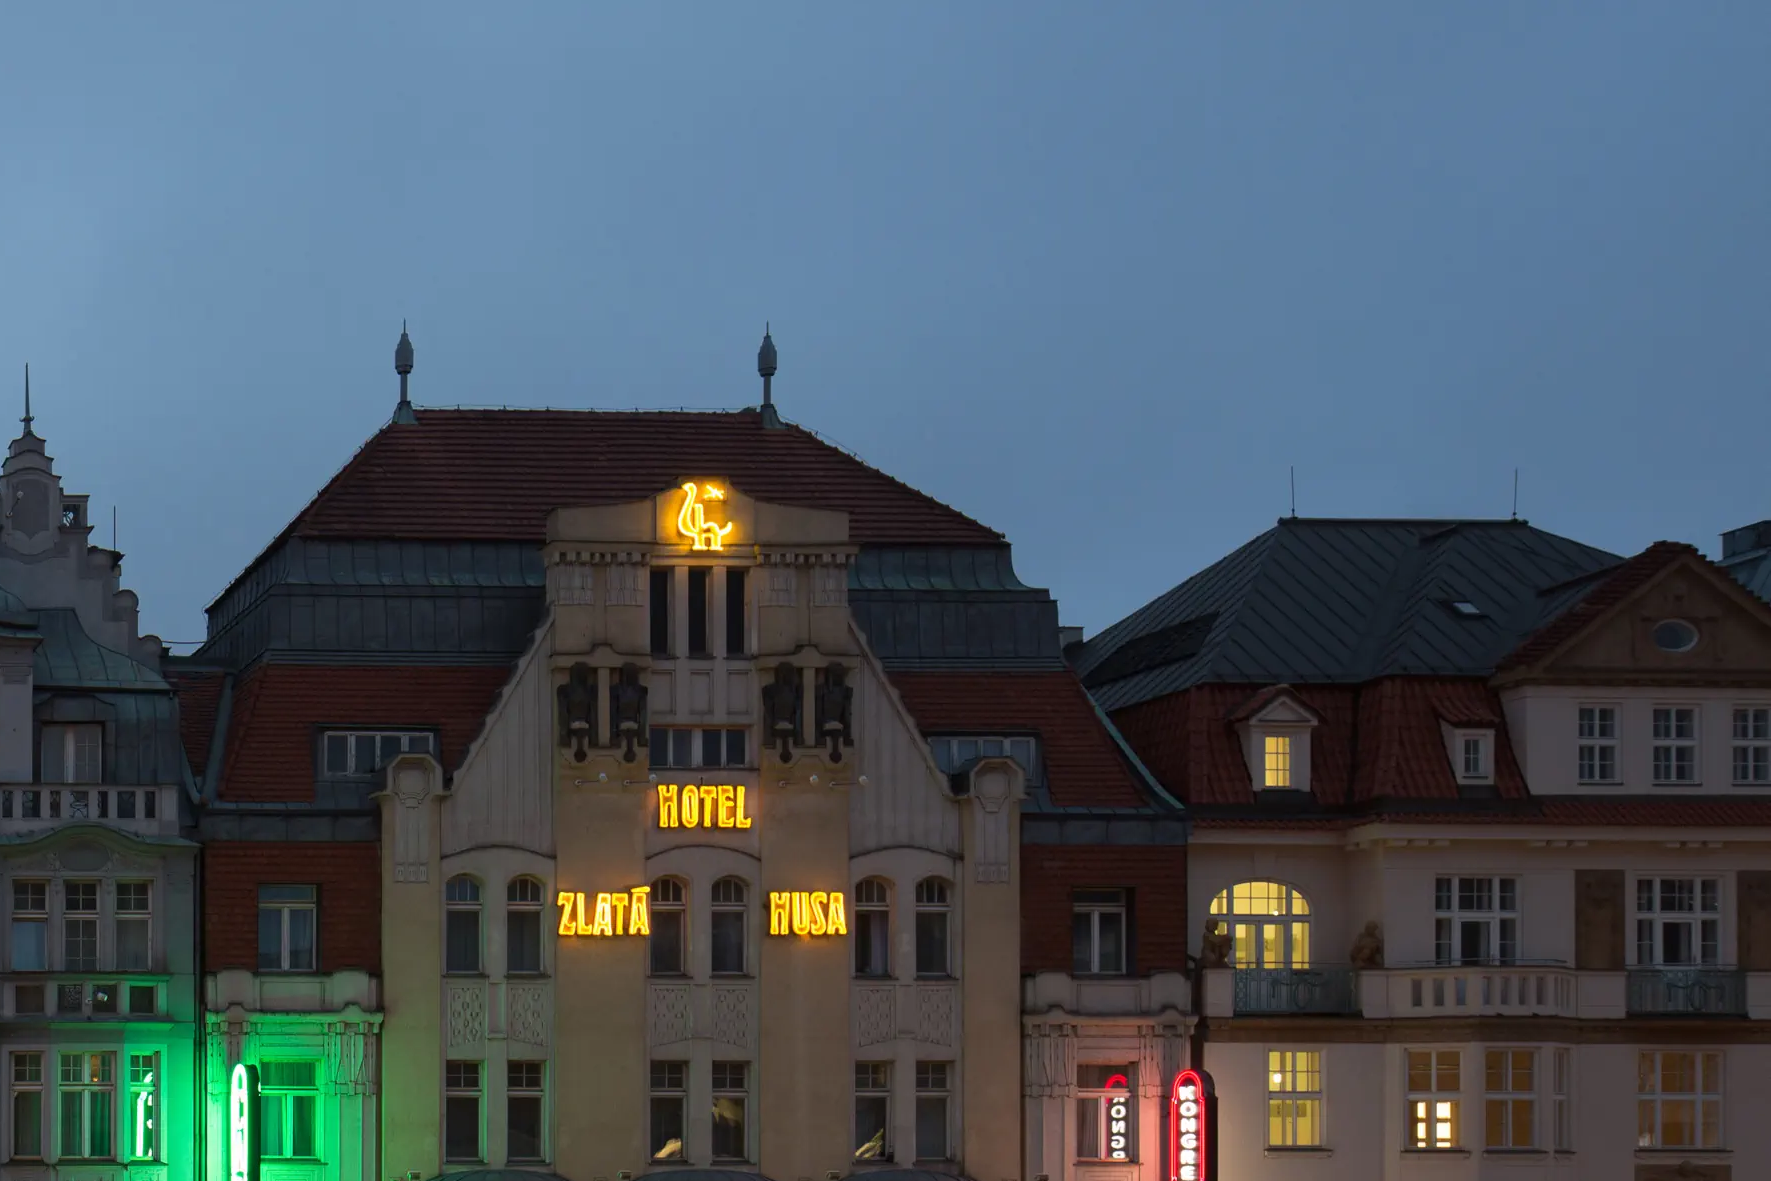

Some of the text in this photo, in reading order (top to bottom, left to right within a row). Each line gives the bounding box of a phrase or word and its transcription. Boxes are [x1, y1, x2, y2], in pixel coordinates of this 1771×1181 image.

[657, 784, 752, 828] HOTEL
[557, 886, 847, 936] ZLATÁ HUSA
